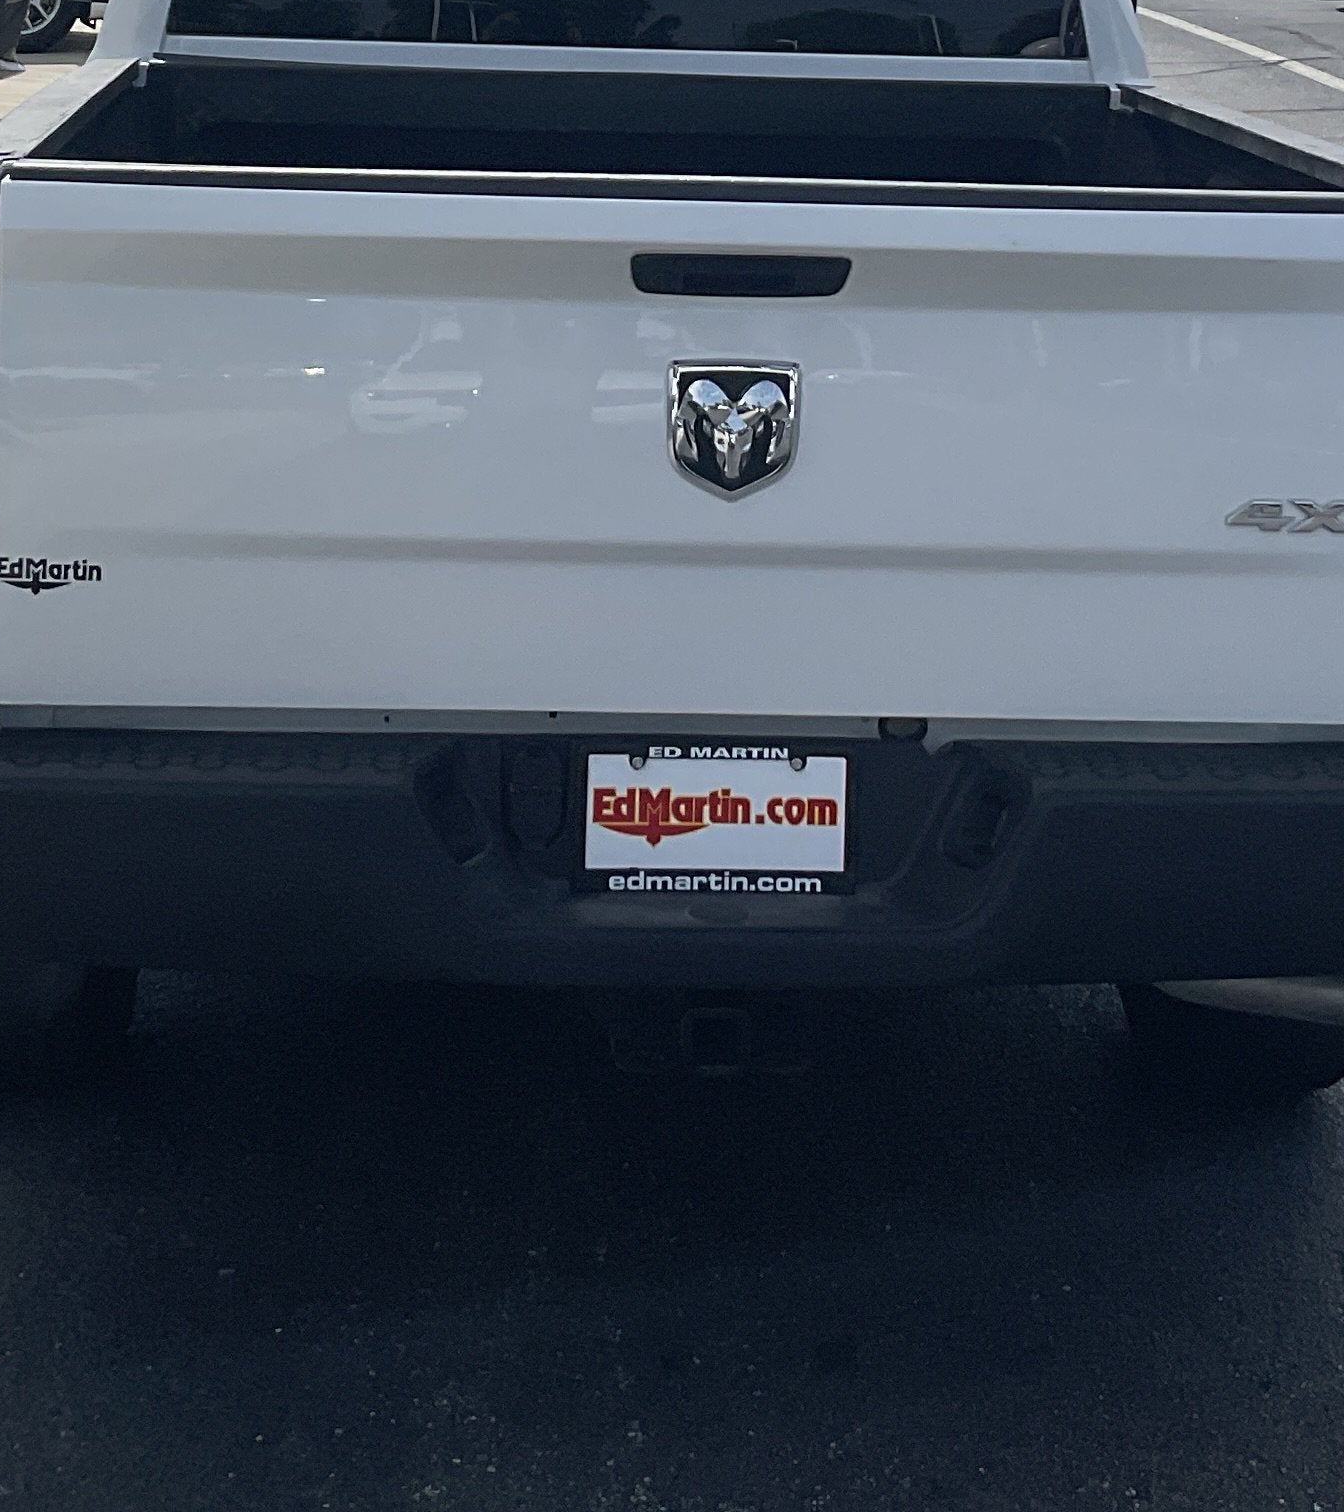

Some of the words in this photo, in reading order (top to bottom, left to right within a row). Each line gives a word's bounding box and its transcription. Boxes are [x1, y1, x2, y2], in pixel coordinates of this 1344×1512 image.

[648, 746, 682, 759] ED
[689, 746, 790, 760] MARTIN
[608, 870, 823, 893] edmartin.com
